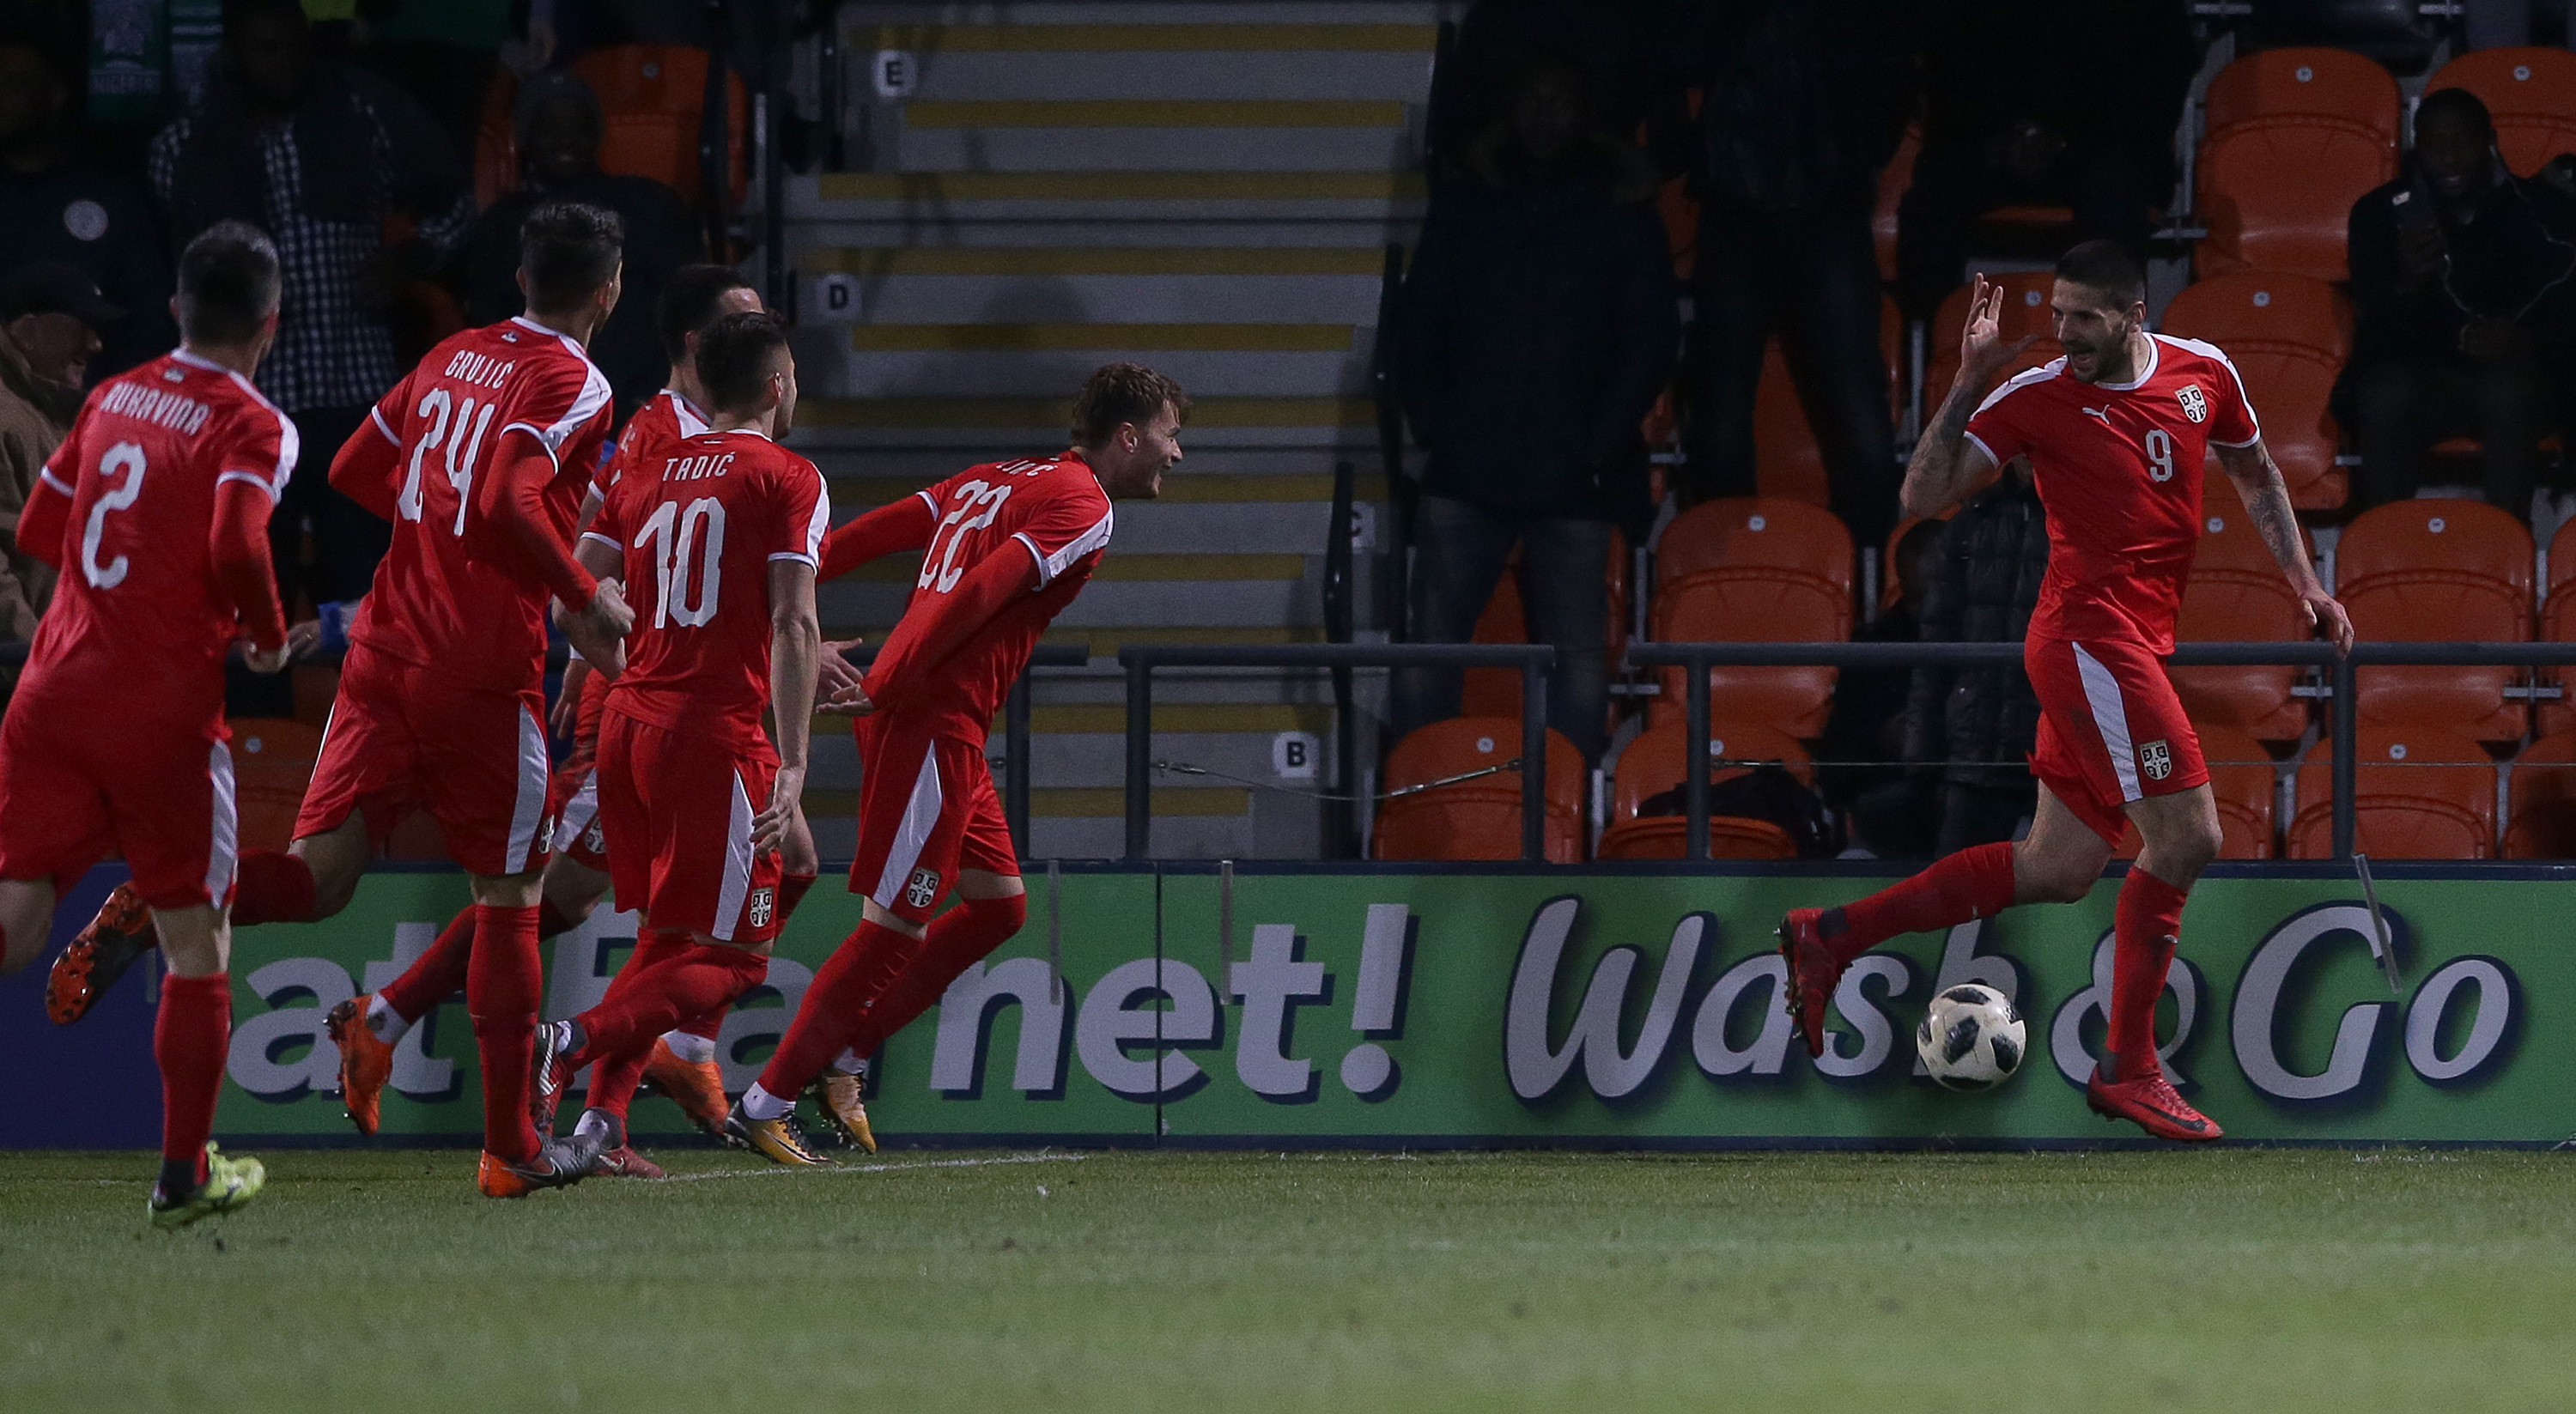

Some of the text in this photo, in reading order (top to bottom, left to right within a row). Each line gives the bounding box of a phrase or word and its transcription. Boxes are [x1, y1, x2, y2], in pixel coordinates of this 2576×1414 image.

[885, 61, 903, 85] E
[829, 284, 848, 309] D
[445, 349, 516, 389] GRUJIĆ
[100, 380, 211, 436] RUKAVINA
[398, 387, 495, 537] 24
[662, 452, 736, 482] TADIĆ
[2145, 428, 2173, 482] 9
[82, 440, 148, 590] 2
[918, 478, 1012, 594] 22
[634, 496, 726, 629] 10
[1287, 742, 1305, 765] B
[226, 922, 454, 1095] at
[2233, 905, 2510, 1100] Go
